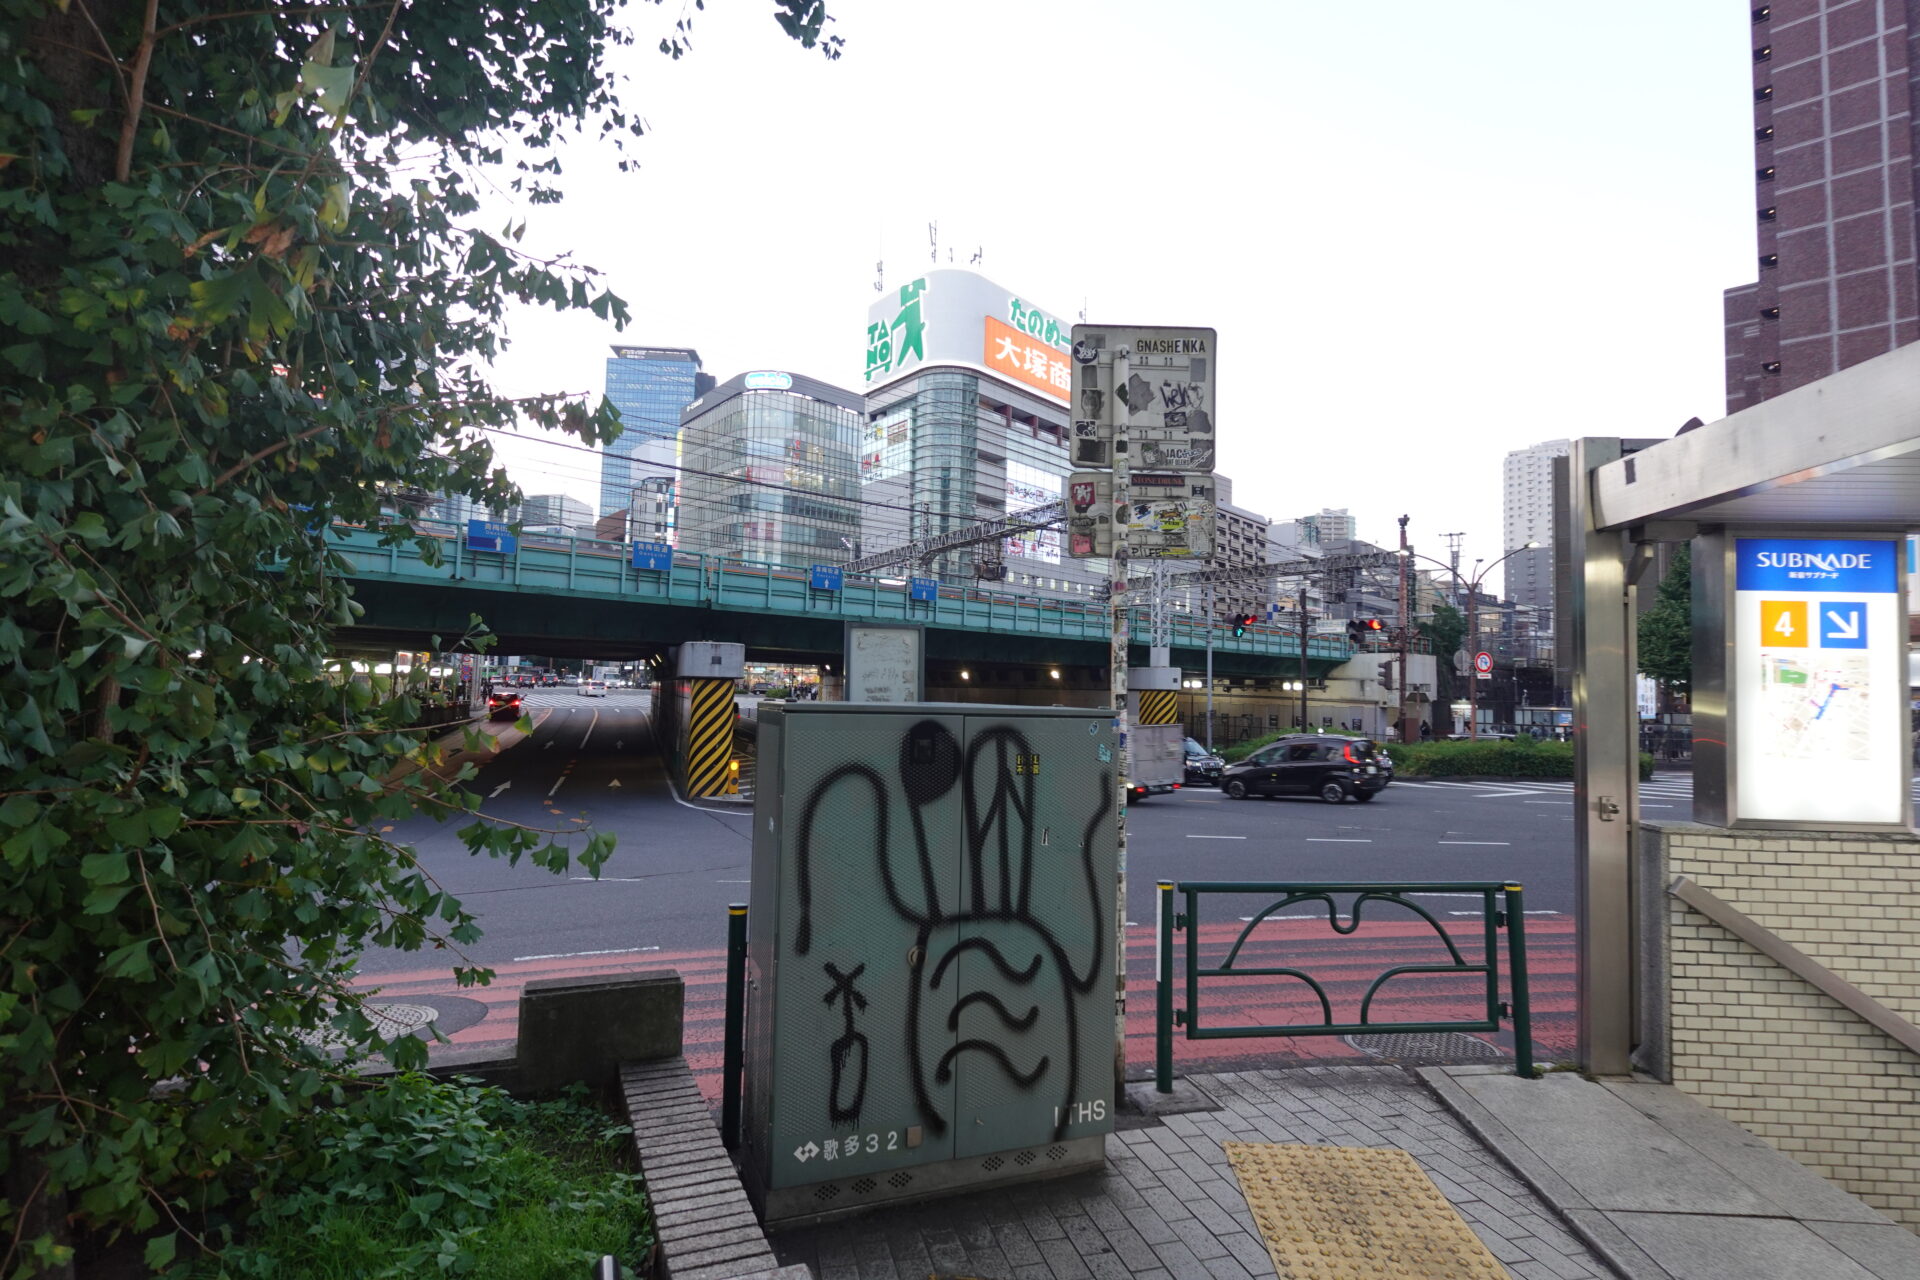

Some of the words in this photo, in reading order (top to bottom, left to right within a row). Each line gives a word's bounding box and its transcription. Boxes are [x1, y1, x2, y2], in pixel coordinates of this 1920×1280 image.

[867, 319, 890, 342] TA
[866, 339, 891, 370] NO
[1136, 339, 1206, 353] GNASHENKA
[995, 336, 1071, 392] 大塚商
[1756, 551, 1872, 571] SUBNADE
[1773, 610, 1795, 637] 4
